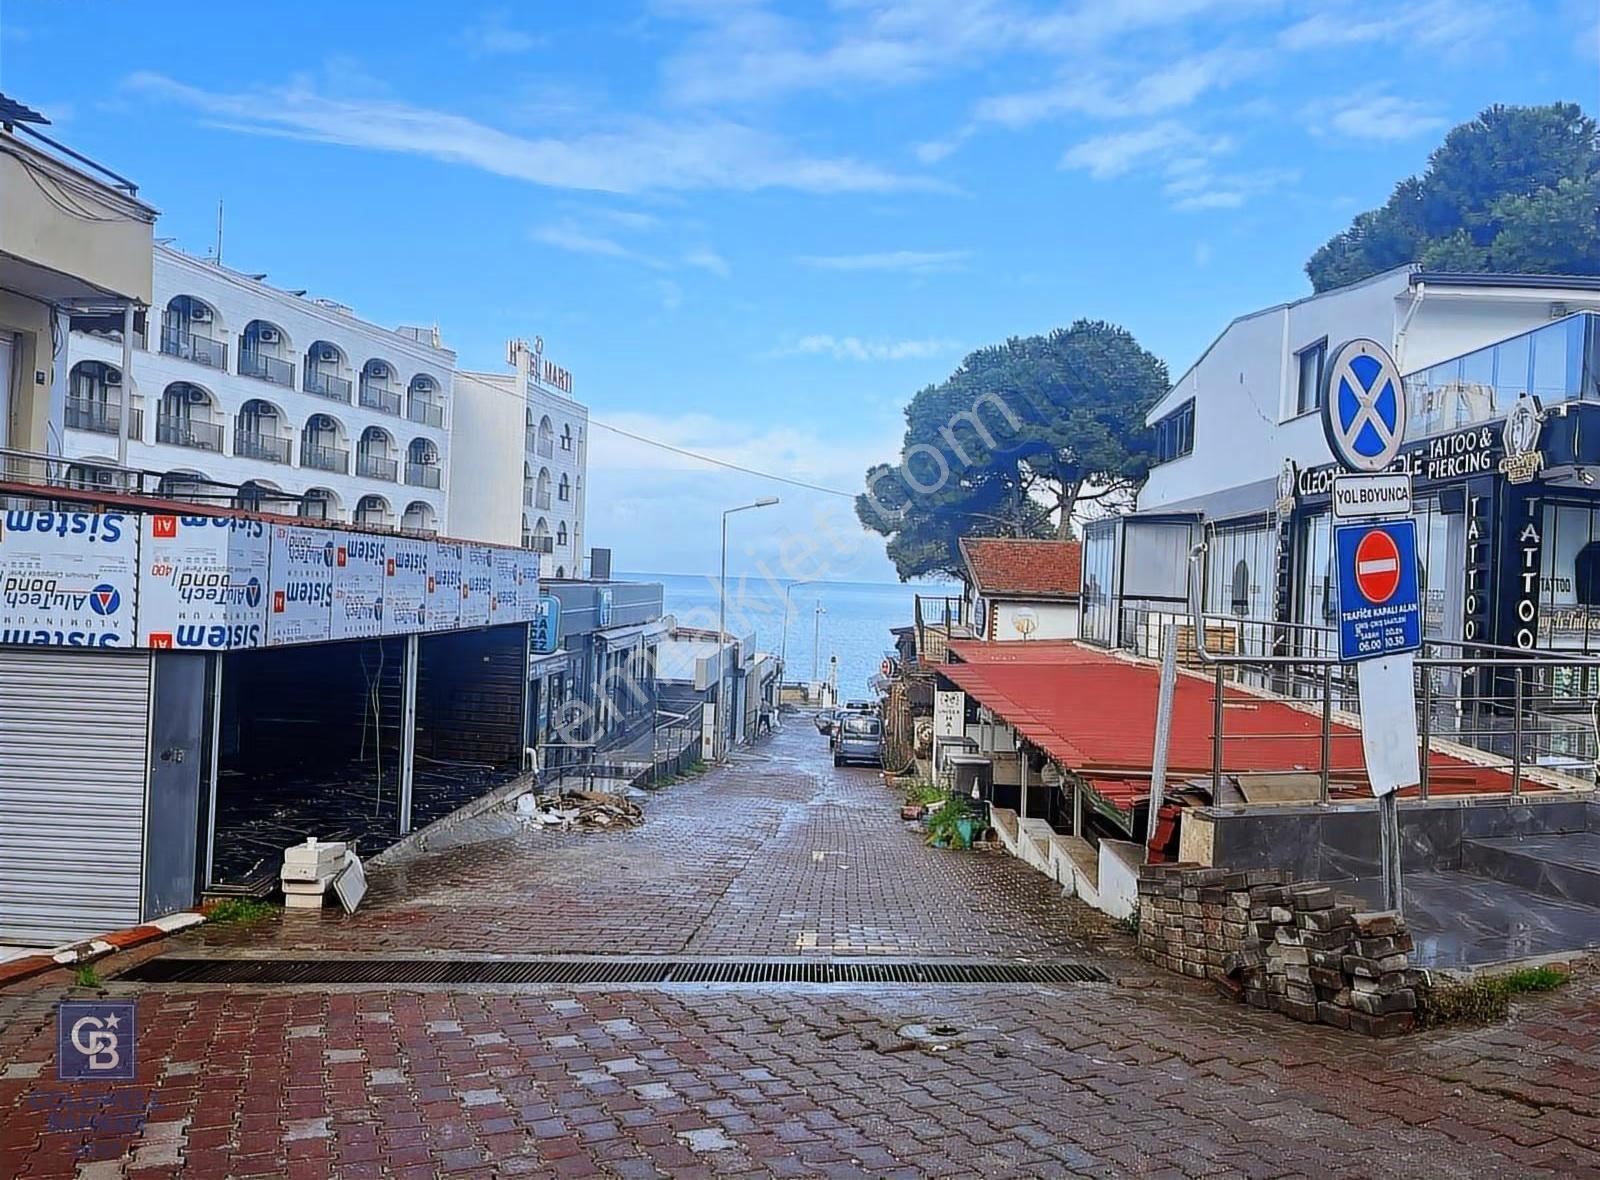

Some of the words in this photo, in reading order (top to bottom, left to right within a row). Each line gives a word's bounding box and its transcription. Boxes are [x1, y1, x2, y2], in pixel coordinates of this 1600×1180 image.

[1430, 432, 1477, 459] TATTOO
[1480, 427, 1492, 448] &
[1428, 450, 1491, 479] PIERCING
[1337, 489, 1358, 504] YOL
[1360, 487, 1409, 503] BOYUNCA
[6, 510, 124, 543] Sistem
[348, 539, 385, 565] Sistem
[395, 551, 428, 575] Sistem
[1465, 497, 1480, 641] TATTOO
[1517, 497, 1540, 649] TATTOO
[4, 578, 57, 598] bond
[179, 573, 230, 592] bond
[286, 582, 332, 608] Sistem
[6, 592, 88, 611] AluTech
[1399, 602, 1417, 613] ALAN
[176, 624, 260, 648] Sistem
